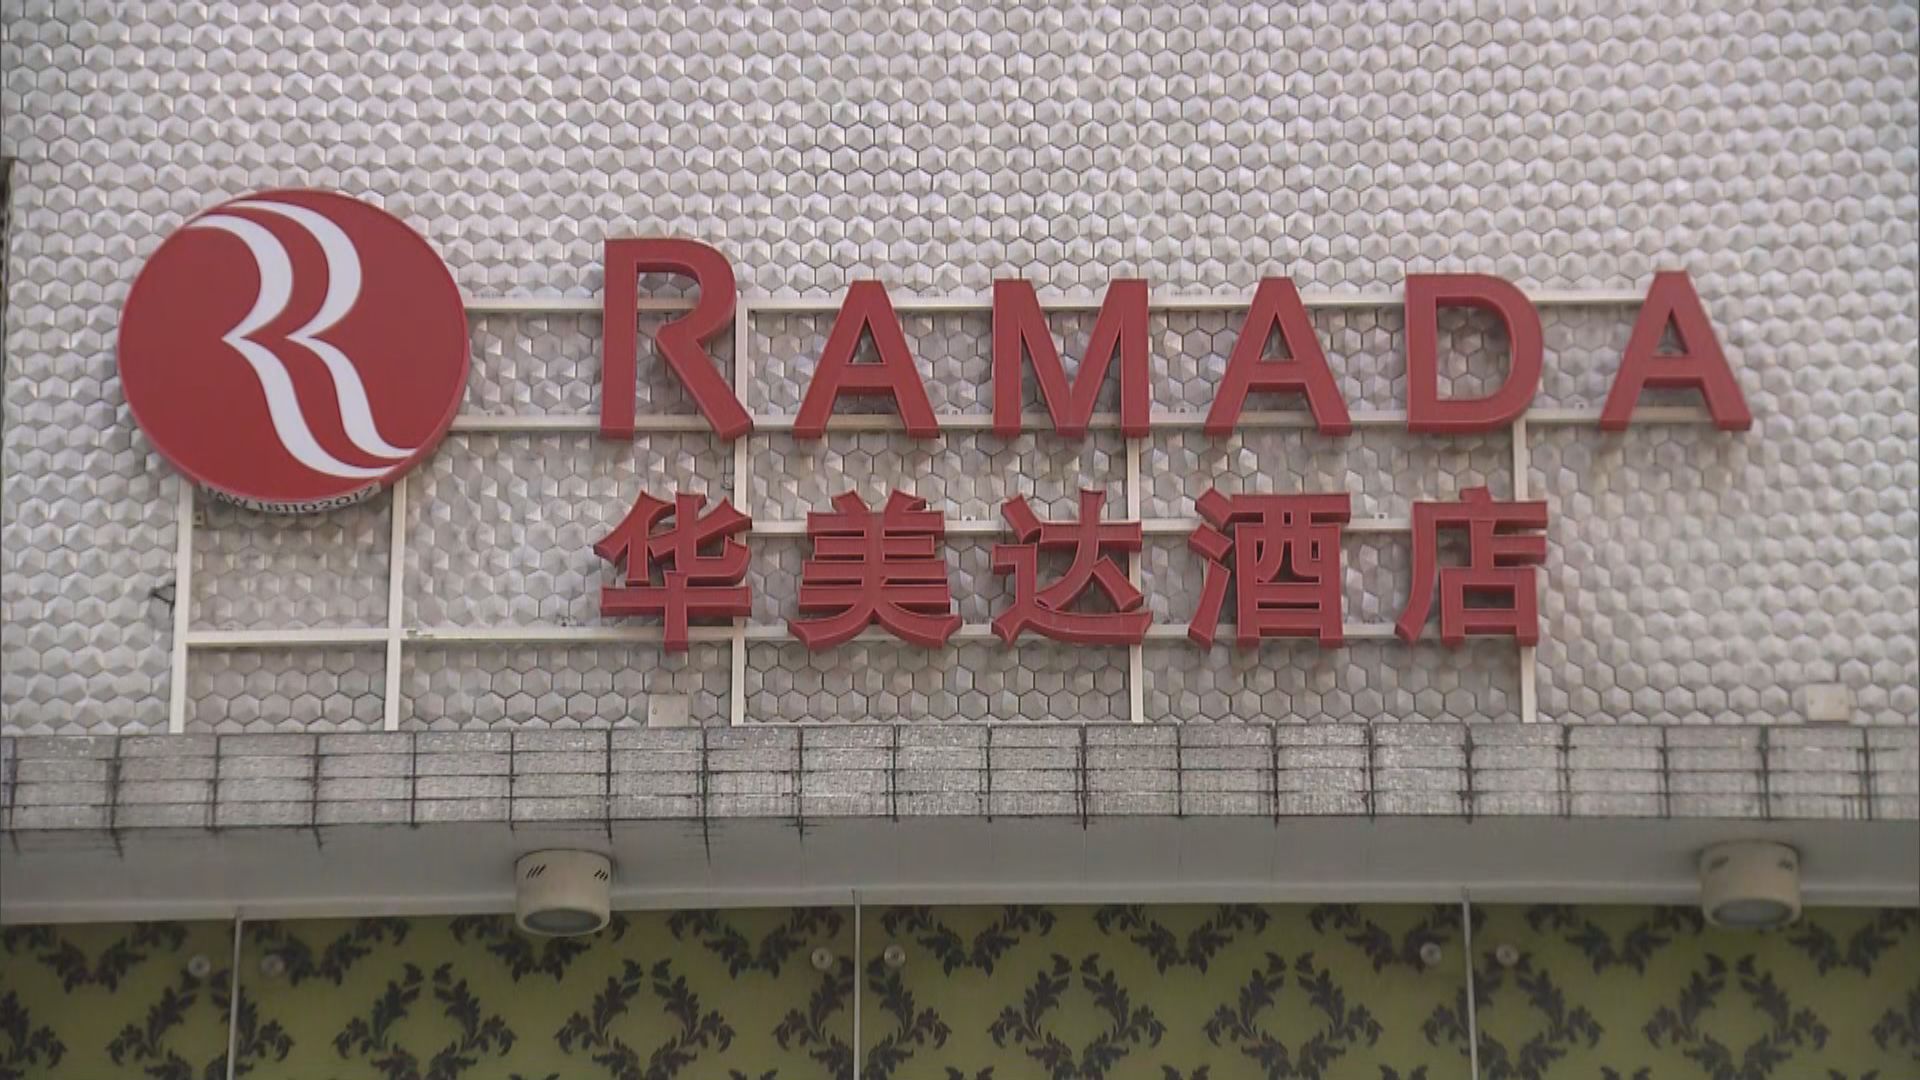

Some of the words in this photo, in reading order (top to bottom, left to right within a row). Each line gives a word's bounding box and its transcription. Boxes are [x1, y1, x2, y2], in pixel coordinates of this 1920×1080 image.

[601, 237, 1751, 444] RAMADA
[595, 487, 1548, 653] 华美达酒店
